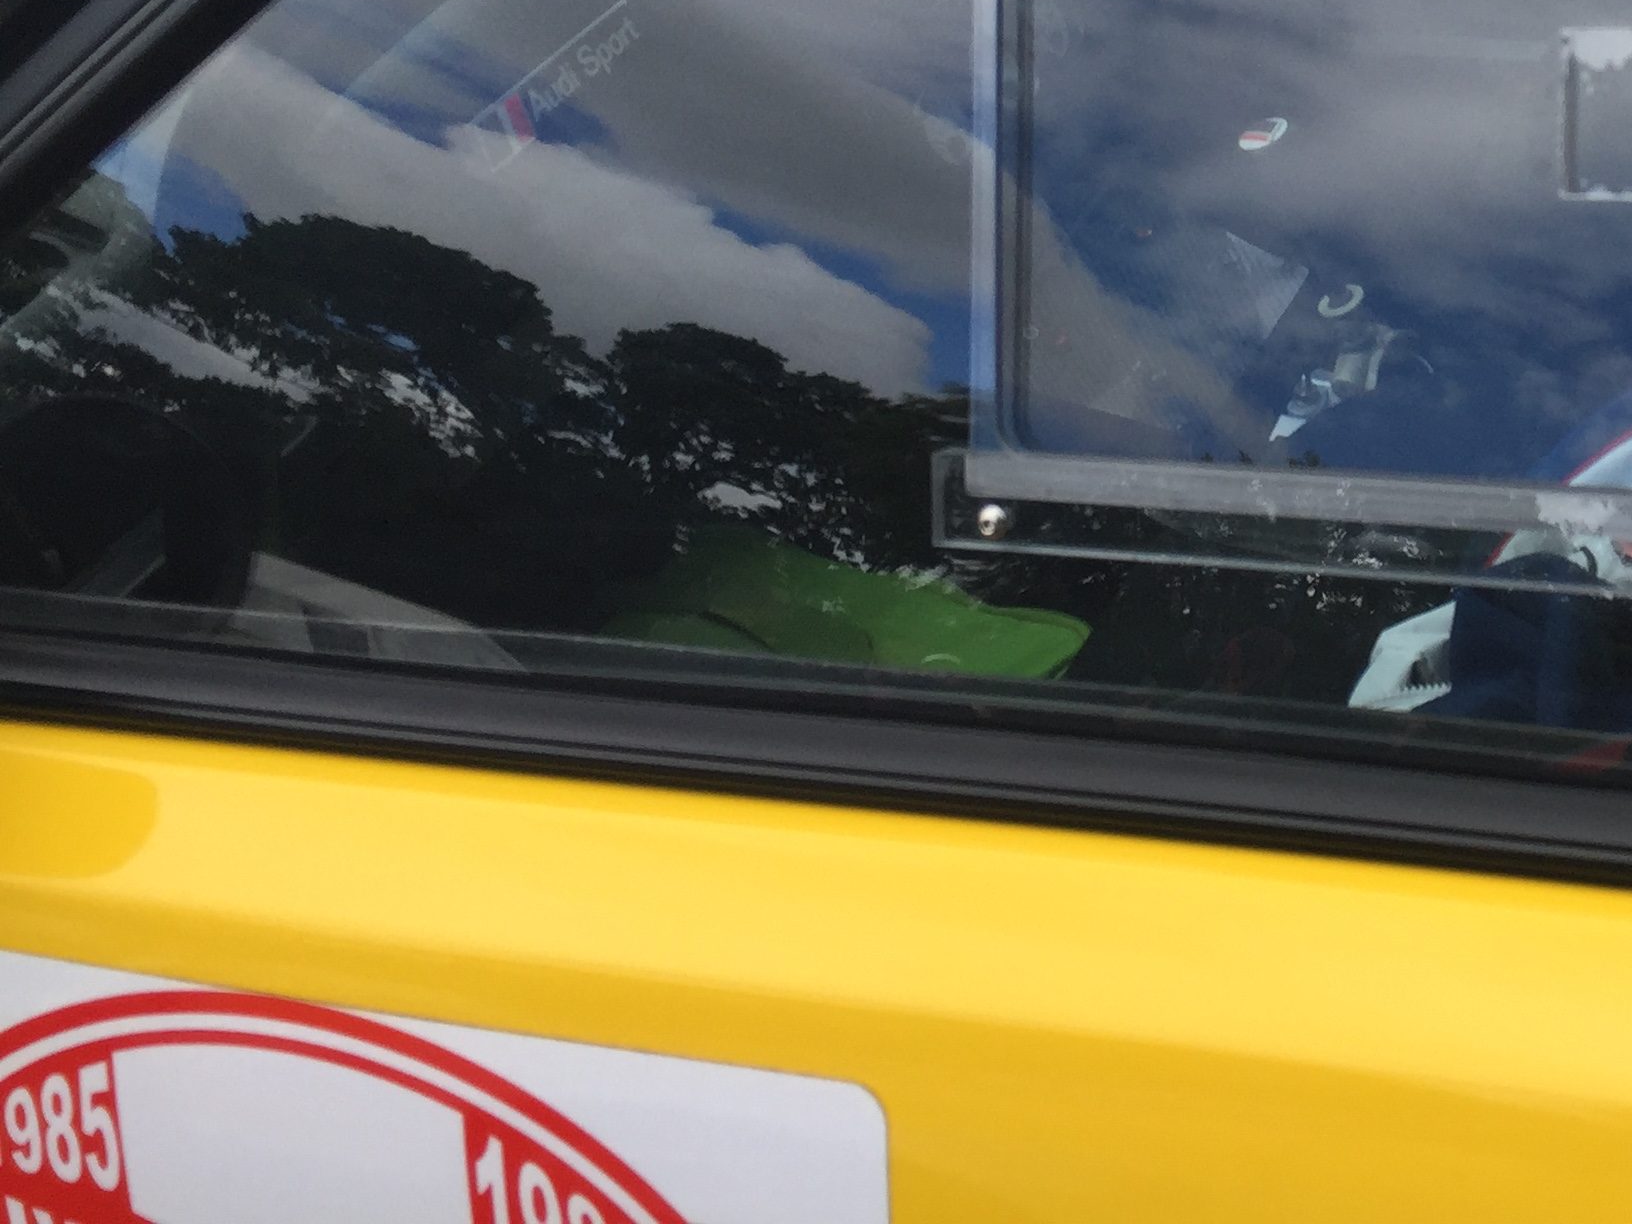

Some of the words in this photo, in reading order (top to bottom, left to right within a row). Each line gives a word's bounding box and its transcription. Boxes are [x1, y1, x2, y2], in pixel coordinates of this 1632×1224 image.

[527, 63, 581, 121] Audi
[576, 17, 640, 76] Sport
[0, 1061, 120, 1192] 985
